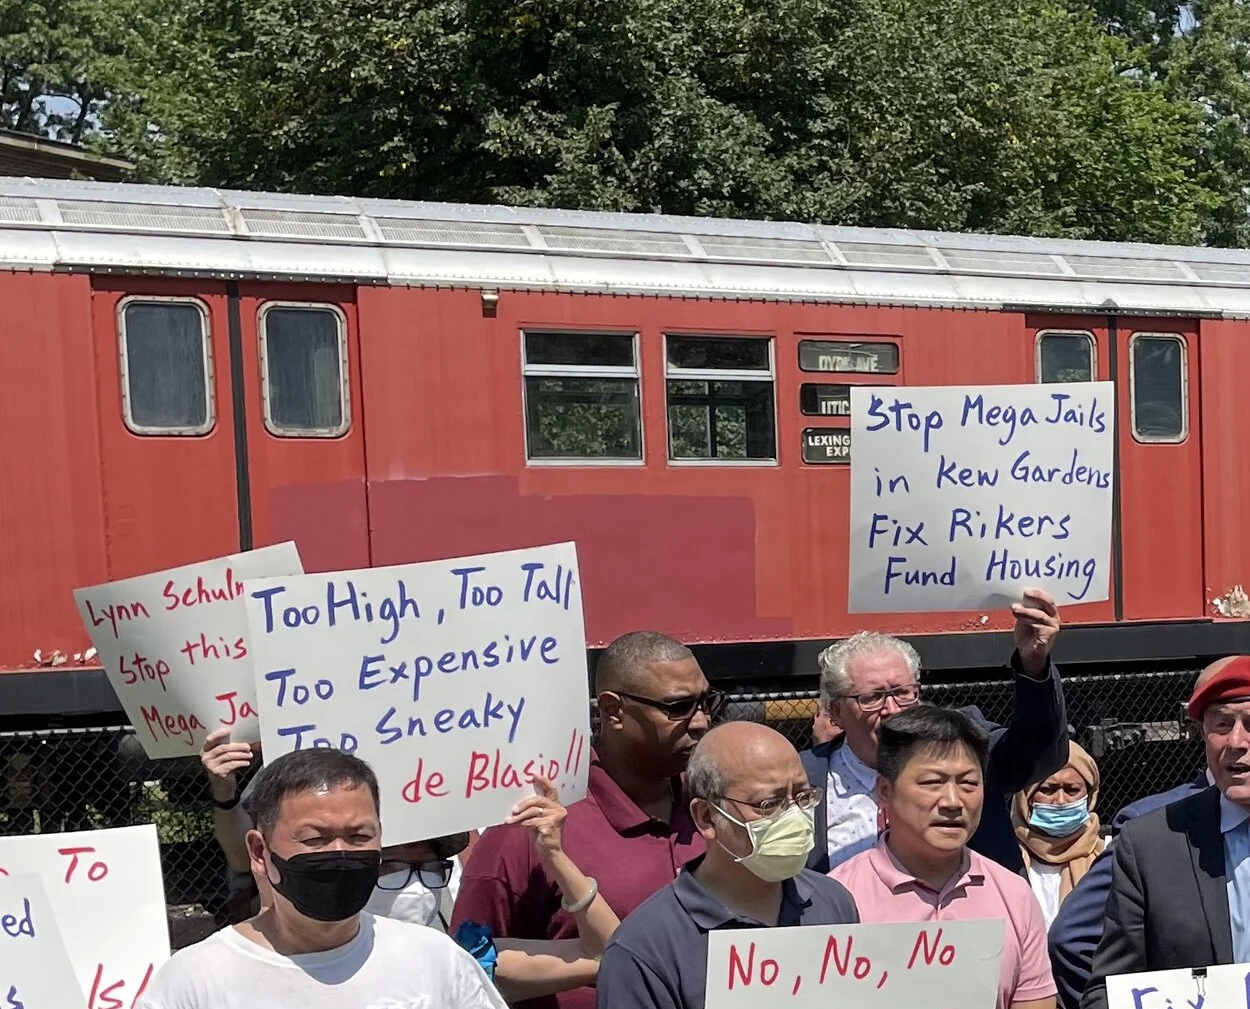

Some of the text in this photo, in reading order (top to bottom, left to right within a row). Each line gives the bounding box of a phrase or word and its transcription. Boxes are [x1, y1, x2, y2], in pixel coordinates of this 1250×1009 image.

[866, 393, 1106, 452] Stop Mega Jails
[874, 467, 910, 496] in
[1010, 449, 1111, 488] Gardens
[868, 504, 1071, 548] Fix Rikers
[251, 586, 320, 633] Too
[450, 566, 503, 610] Too
[521, 563, 573, 610] Tall
[884, 548, 1096, 600] Fund Housing
[85, 599, 150, 639] Lynn
[119, 633, 247, 691] Stop this
[265, 635, 560, 707] Too Expensive
[140, 705, 206, 745] Mega
[375, 692, 525, 745] Sneaky
[401, 758, 451, 803] de
[58, 847, 108, 884] To
[728, 928, 955, 996] No, No, No
